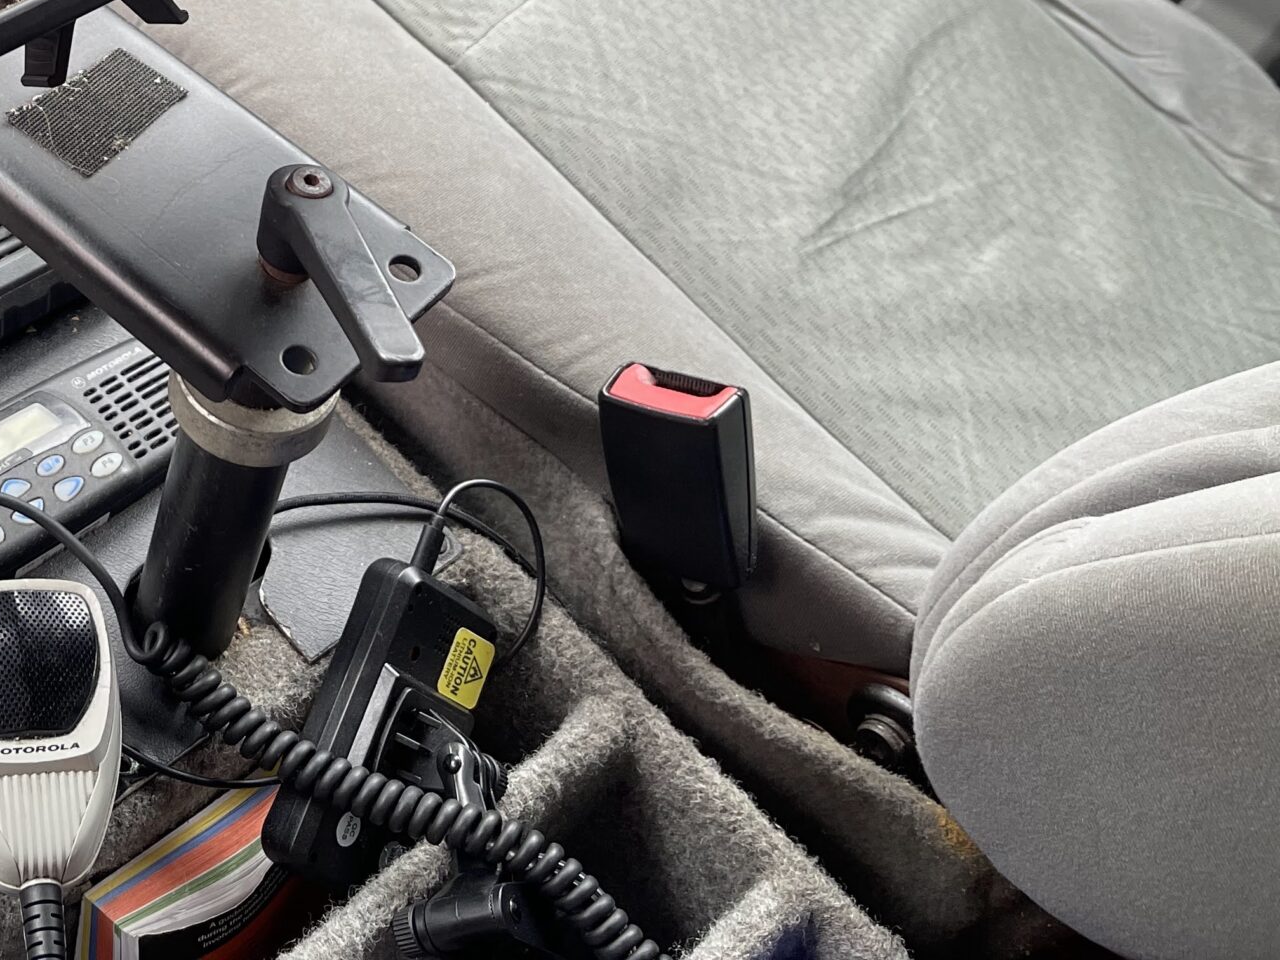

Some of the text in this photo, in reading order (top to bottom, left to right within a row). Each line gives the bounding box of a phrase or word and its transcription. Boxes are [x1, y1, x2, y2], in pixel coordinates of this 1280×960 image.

[443, 641, 461, 680] BATTERY
[450, 638, 477, 696] CAUTION
[198, 915, 243, 942] during the
